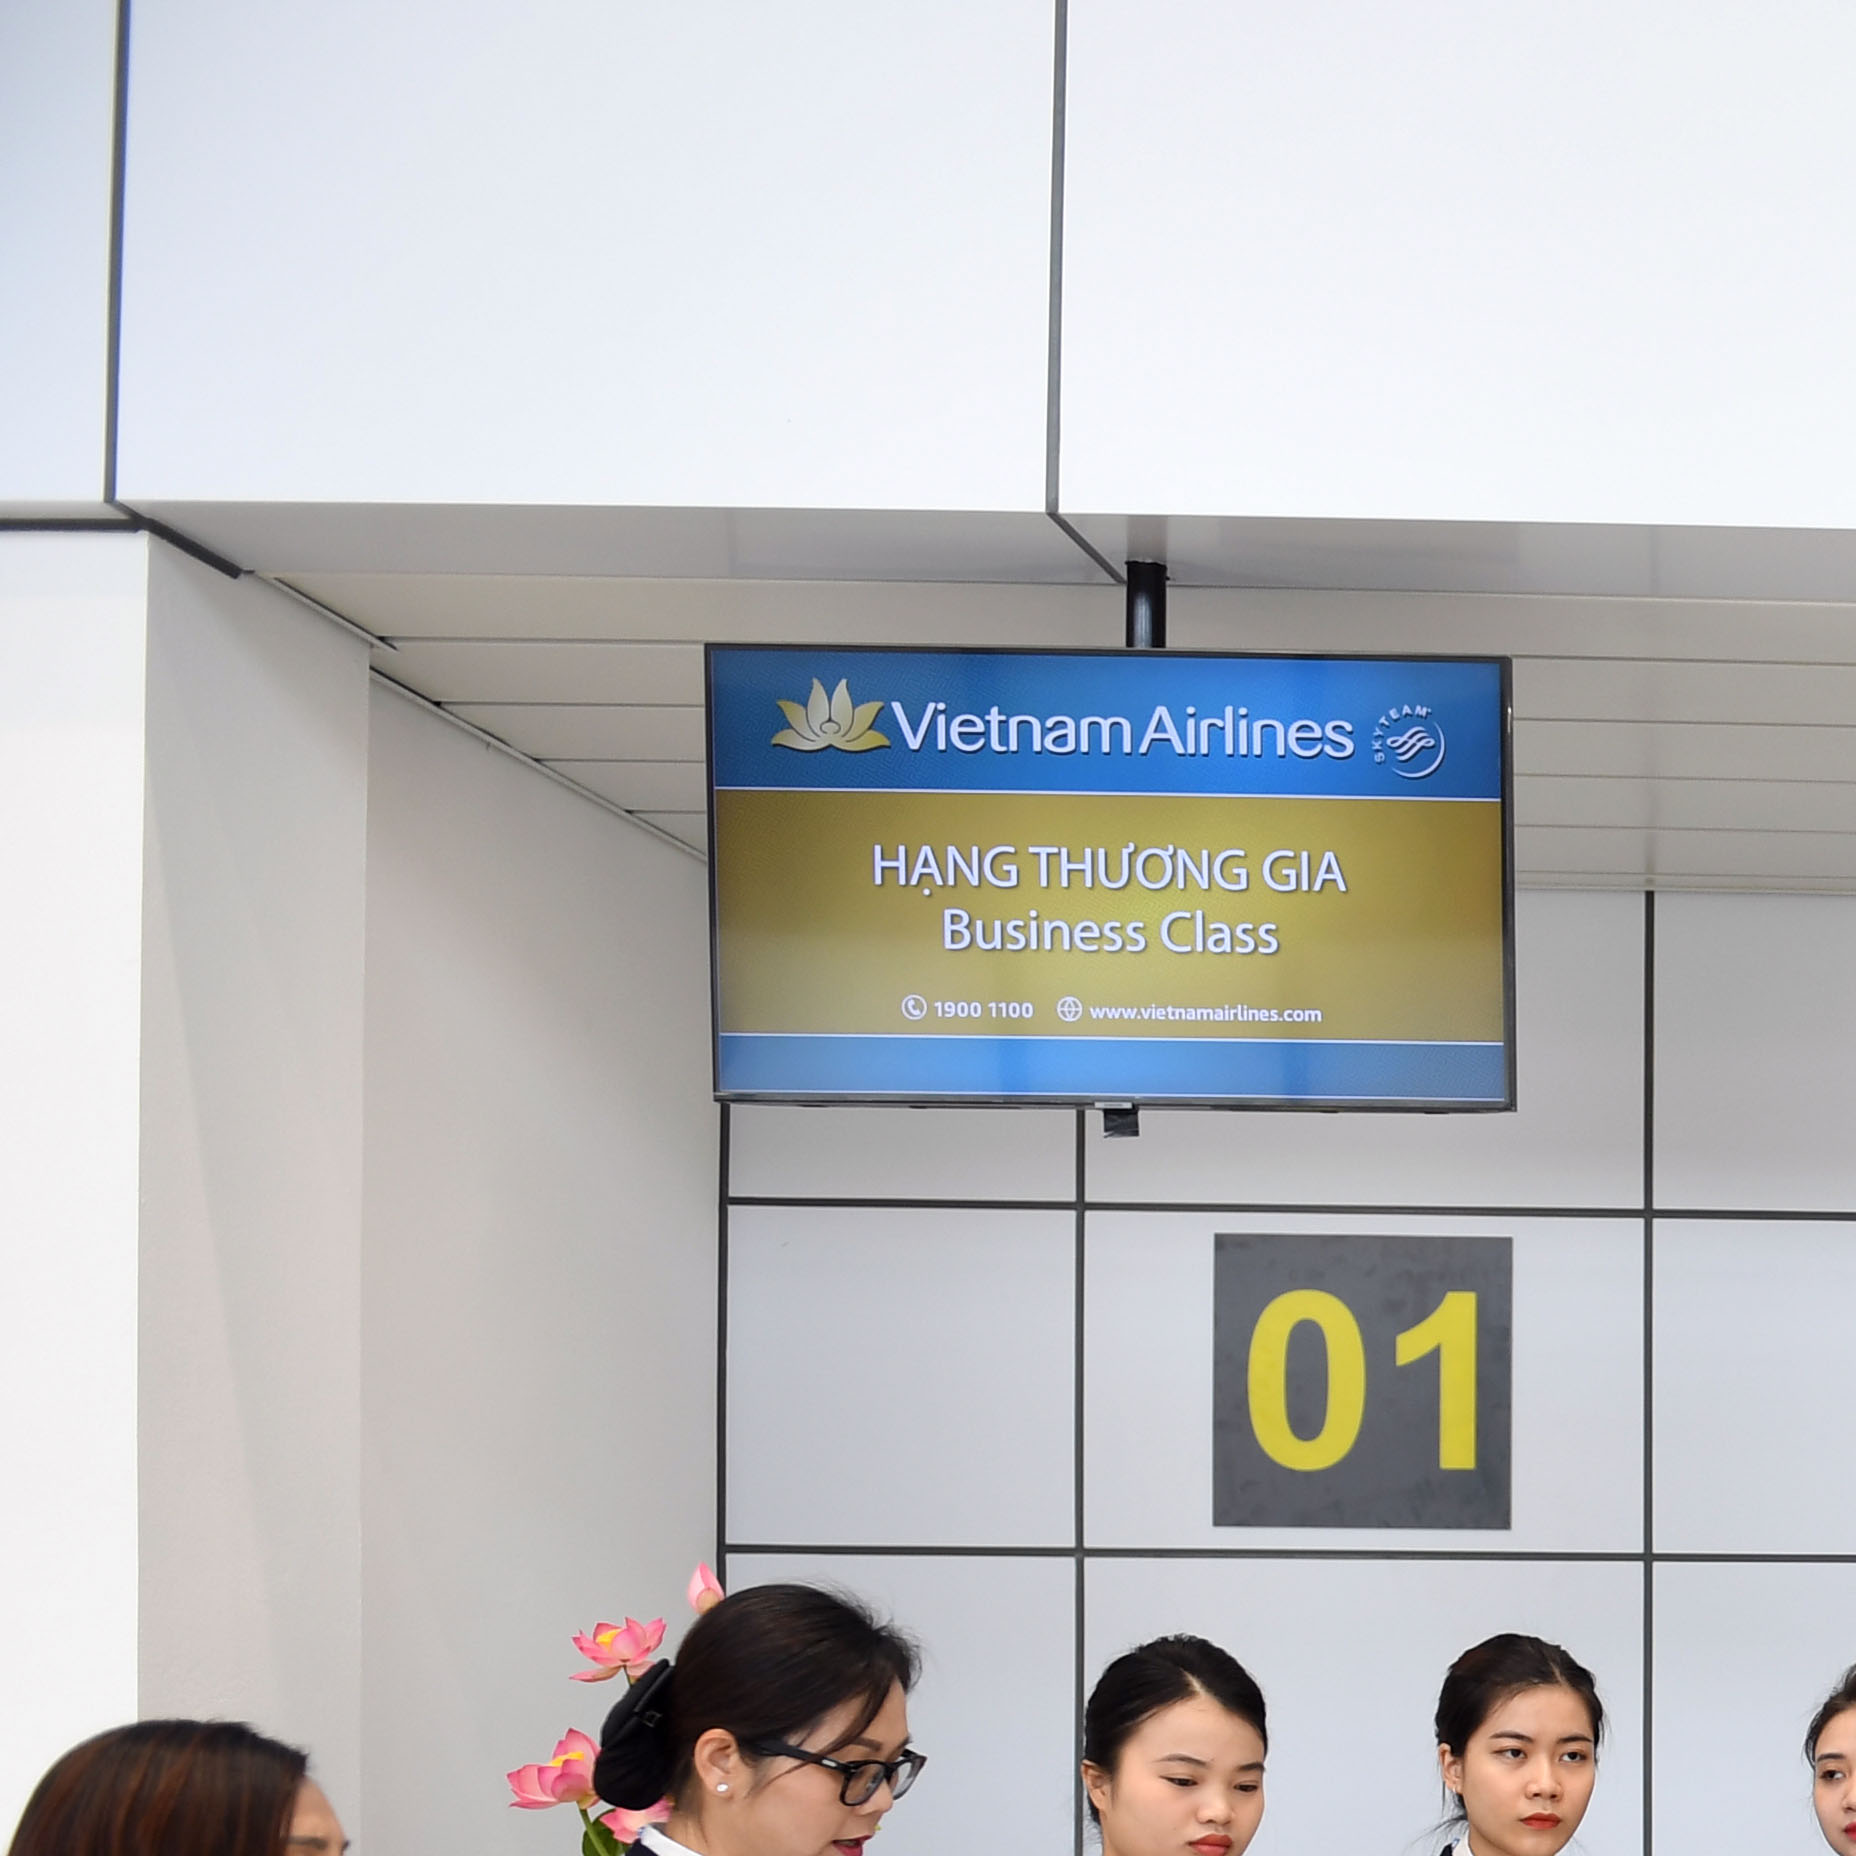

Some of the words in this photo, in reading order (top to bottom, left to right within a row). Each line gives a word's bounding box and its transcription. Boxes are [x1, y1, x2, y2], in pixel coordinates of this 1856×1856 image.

[890, 701, 1132, 754] Vietnam
[1139, 705, 1355, 759] Airlines
[1371, 704, 1428, 763] SKYTEAM
[873, 844, 1018, 897] HẠNG
[1027, 841, 1249, 892] THƯƠNG
[1261, 849, 1347, 893] GIA
[943, 908, 1146, 953] Business
[1159, 909, 1279, 955] Class
[934, 1001, 982, 1019] 1900
[987, 1001, 1034, 1019] 1100
[1089, 1003, 1323, 1023] www.vietnamairlines.com
[1247, 1288, 1477, 1471] 01
